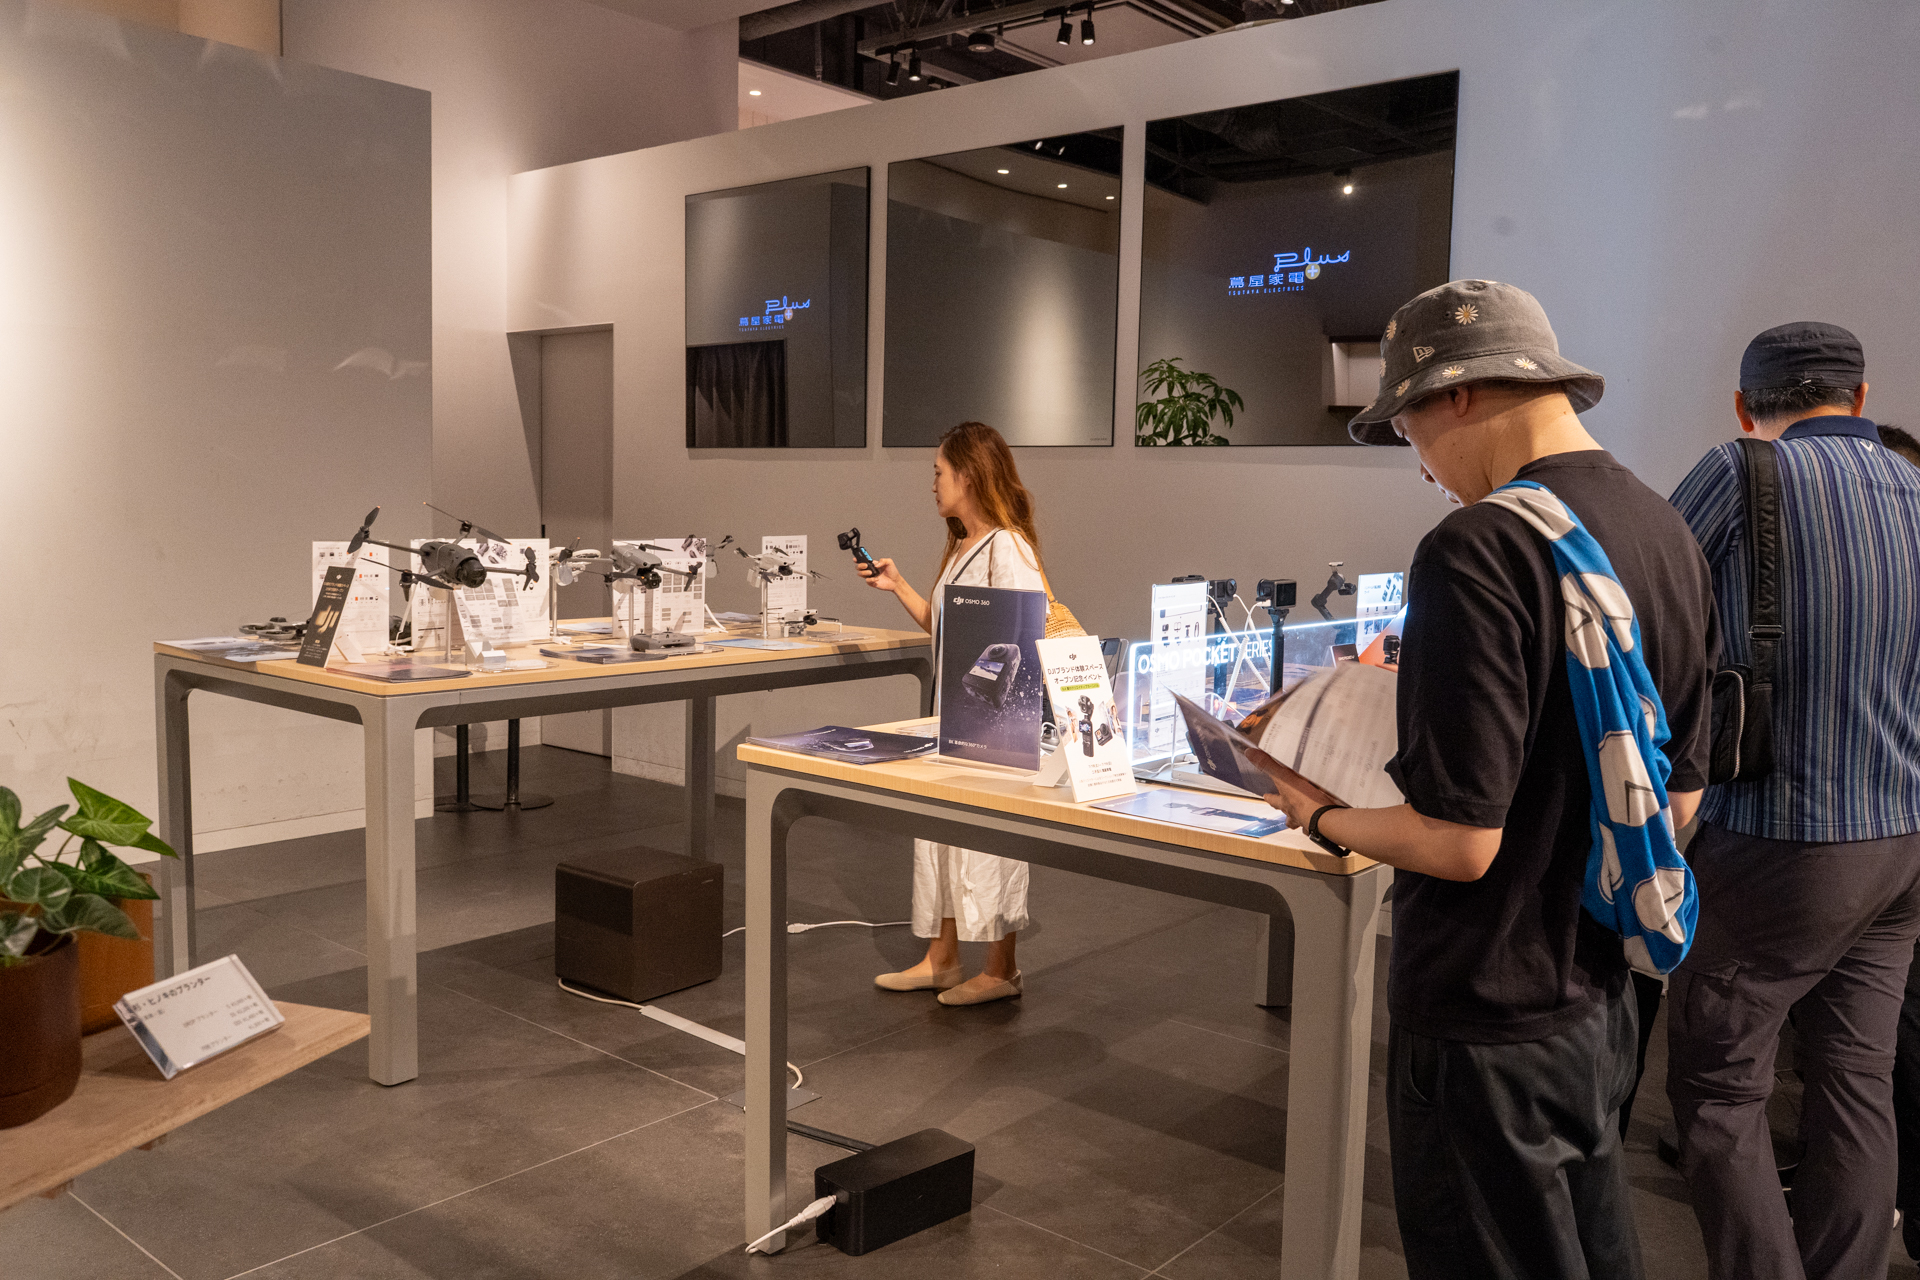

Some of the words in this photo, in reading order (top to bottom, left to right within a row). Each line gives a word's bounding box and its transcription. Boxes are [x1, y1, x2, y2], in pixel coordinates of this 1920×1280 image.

[1273, 247, 1350, 273] Plus
[1228, 288, 1260, 296] TSUTAYA
[1263, 285, 1304, 294] ELECTRICS
[765, 295, 811, 315] Plus
[1137, 651, 1180, 674] OSMO
[1182, 643, 1236, 669] POCKET
[1047, 663, 1104, 675] DJIブランド体験スペース
[1054, 674, 1102, 685] オープン記念イベント
